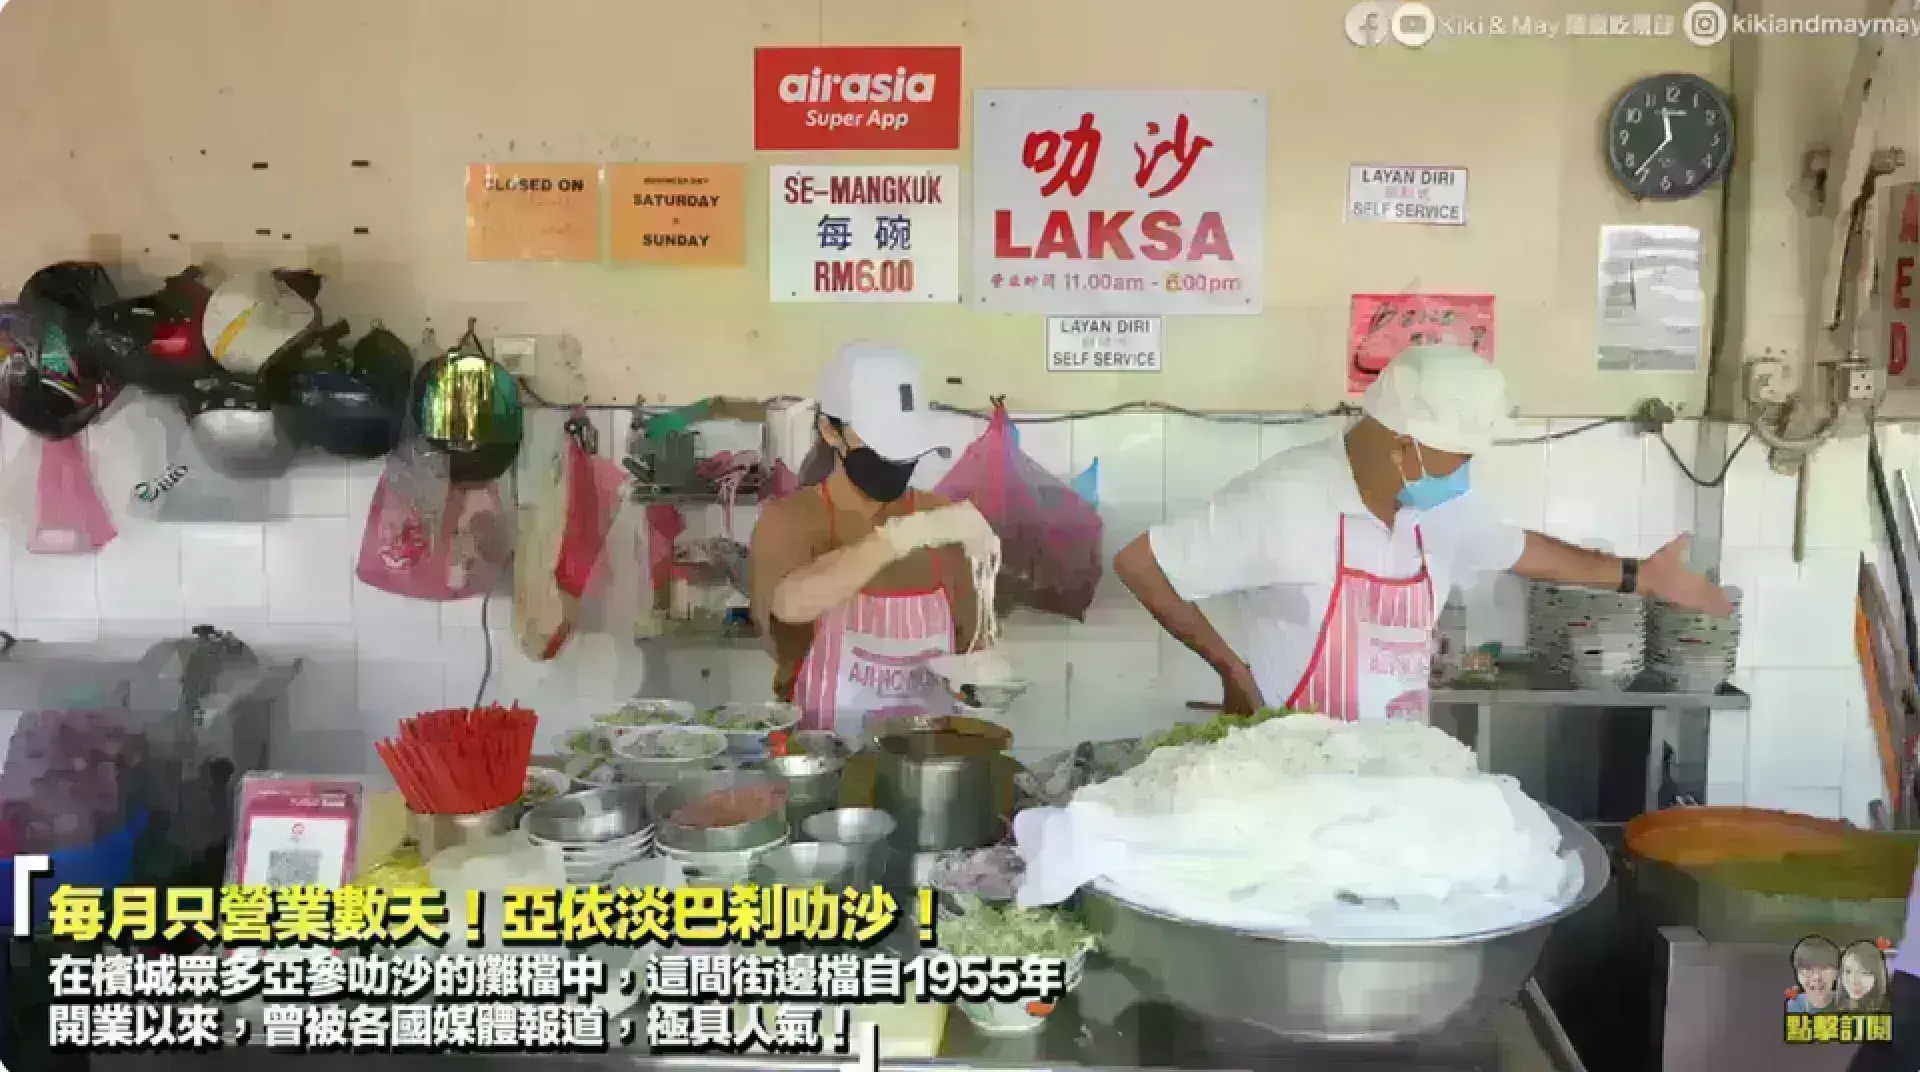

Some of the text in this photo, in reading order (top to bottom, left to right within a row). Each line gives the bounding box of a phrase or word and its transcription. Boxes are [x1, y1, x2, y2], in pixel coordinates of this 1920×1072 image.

[779, 66, 937, 103] airasia
[805, 110, 909, 131] Super App
[1023, 112, 1214, 197] 叻沙
[484, 177, 585, 192] CLOSED ON
[1362, 169, 1455, 185] LAYAN DIRI
[633, 193, 720, 206] SATURDAY
[784, 175, 943, 204] SE-MANGKUK
[1353, 201, 1459, 219] SELF SERVICE
[643, 233, 709, 247] SUNDAY
[817, 214, 913, 250] 每碗
[994, 209, 1235, 260] LAKSA
[814, 259, 915, 292] RM6.00
[1064, 273, 1145, 291] 11.00am
[1166, 273, 1242, 294] 6.00pm
[1060, 319, 1151, 333] LAYAN DIRI
[1053, 351, 1156, 367] SELF SERVICE
